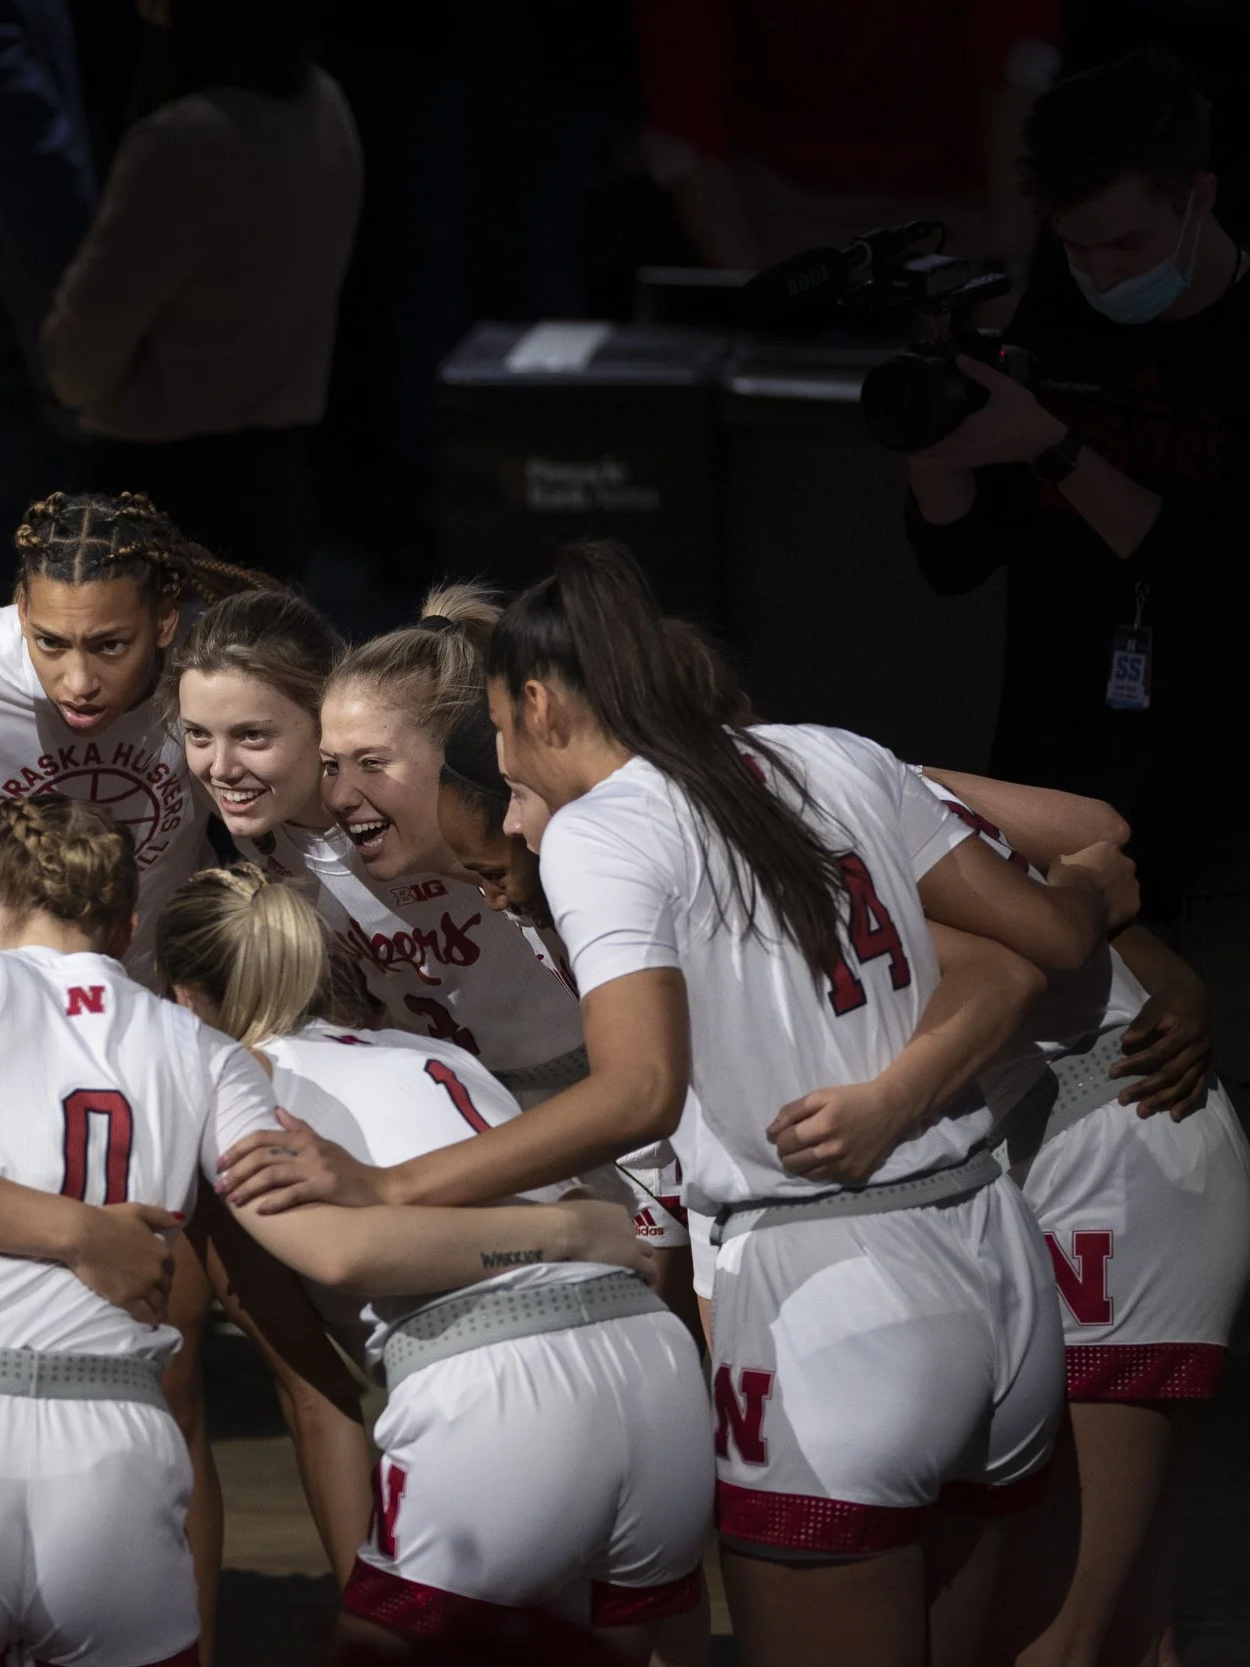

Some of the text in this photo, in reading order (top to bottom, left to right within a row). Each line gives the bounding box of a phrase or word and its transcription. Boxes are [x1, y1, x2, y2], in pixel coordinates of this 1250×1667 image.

[1116, 655, 1141, 682] SS
[112, 742, 183, 833] HUSKERS
[66, 986, 105, 1016] N
[714, 1364, 774, 1466] N
